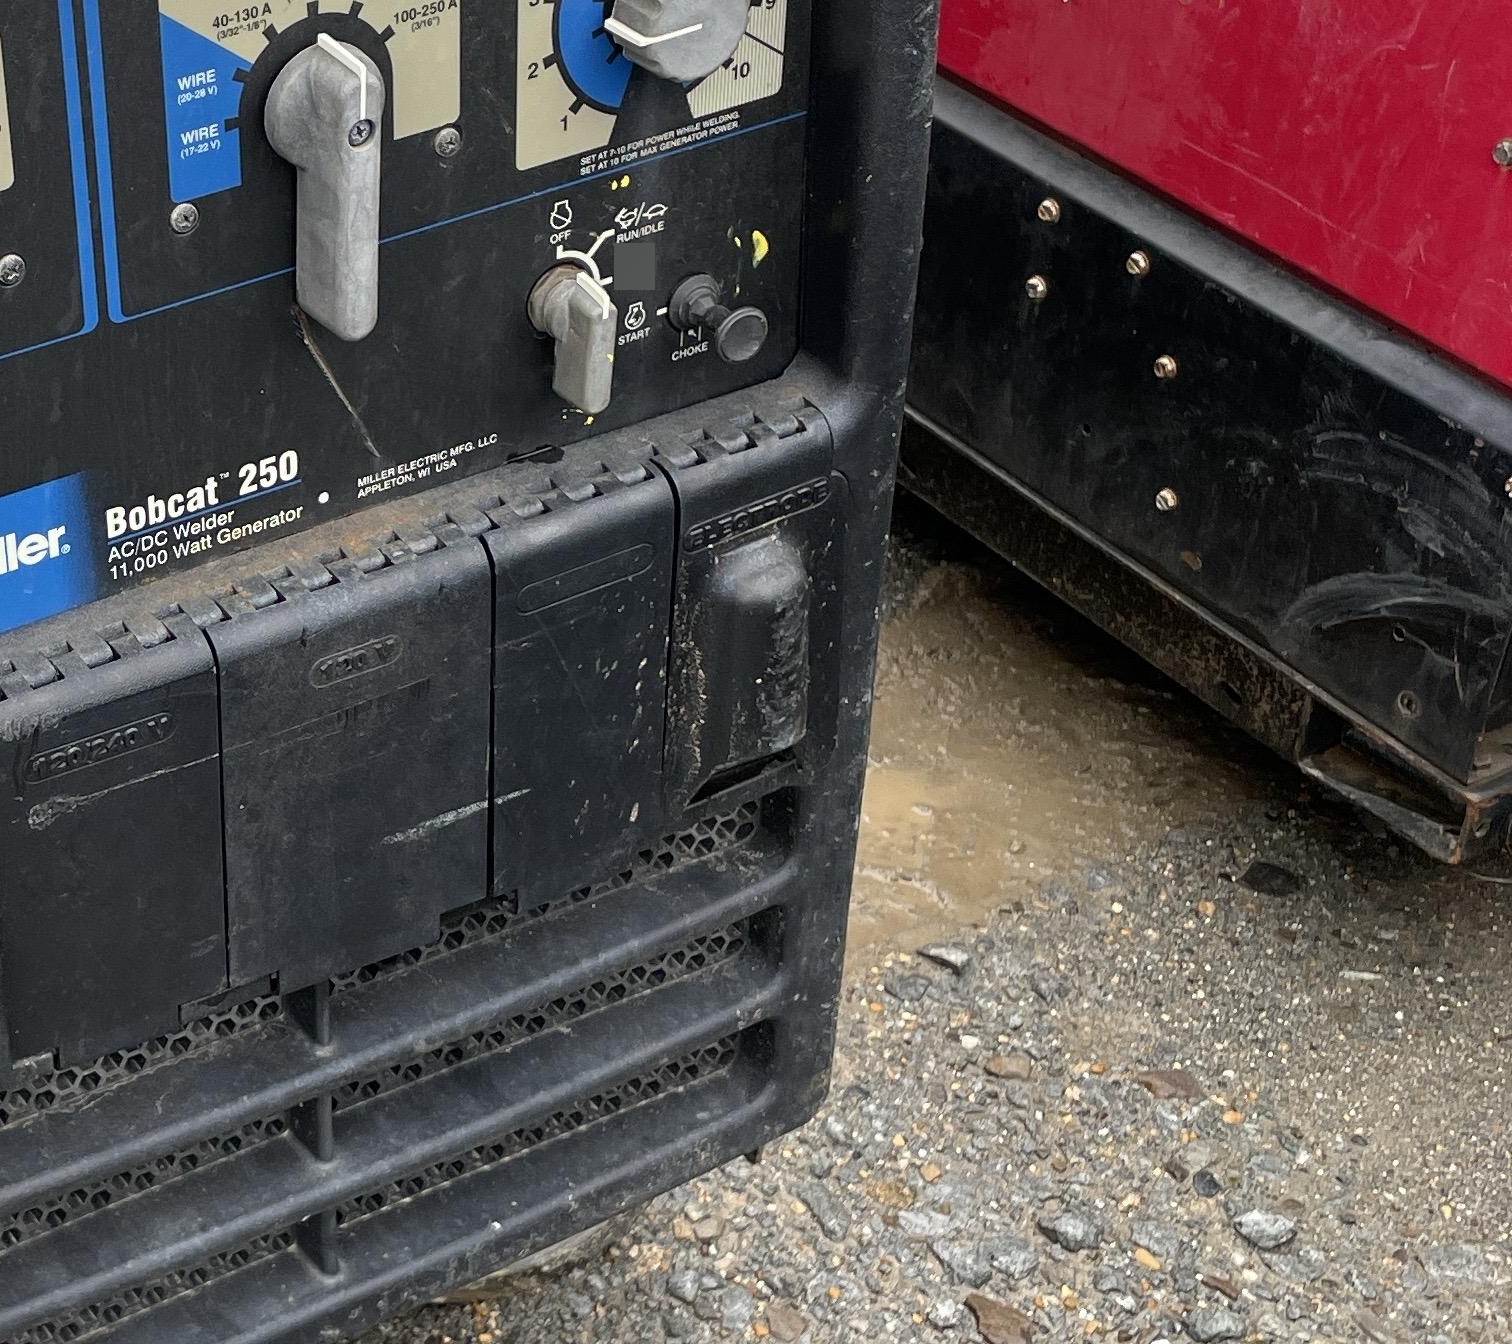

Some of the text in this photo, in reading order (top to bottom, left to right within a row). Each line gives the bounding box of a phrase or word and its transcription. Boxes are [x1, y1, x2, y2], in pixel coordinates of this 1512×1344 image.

[212, 2, 272, 30] 40-130 A
[392, 1, 447, 25] 100-250
[177, 68, 217, 91] WIRE
[527, 62, 539, 80] 2
[731, 62, 751, 81] 10
[180, 123, 219, 146] WIRE
[560, 115, 569, 131] 1
[580, 154, 596, 166] SET
[598, 150, 607, 160] AT
[627, 140, 644, 151] FOR
[645, 130, 675, 146] POWER
[676, 122, 701, 136] WHILE
[580, 164, 596, 175] SET
[598, 160, 608, 170] AT
[610, 157, 619, 166] 10
[621, 151, 638, 163] FOR
[640, 146, 657, 157] MAX
[659, 130, 708, 151] GENERATOR
[549, 230, 572, 245] OFF
[616, 221, 666, 244] RUN/IDLE
[617, 327, 651, 346] START
[671, 341, 709, 362] CHOKE
[358, 434, 497, 487] MILLER ELECTRIC MFG. LLC
[239, 450, 298, 496] 250
[357, 458, 457, 499] APPLETON, WI USA
[108, 510, 235, 563] AC/DC Welder
[110, 506, 303, 580] 11,000 Watt Generator
